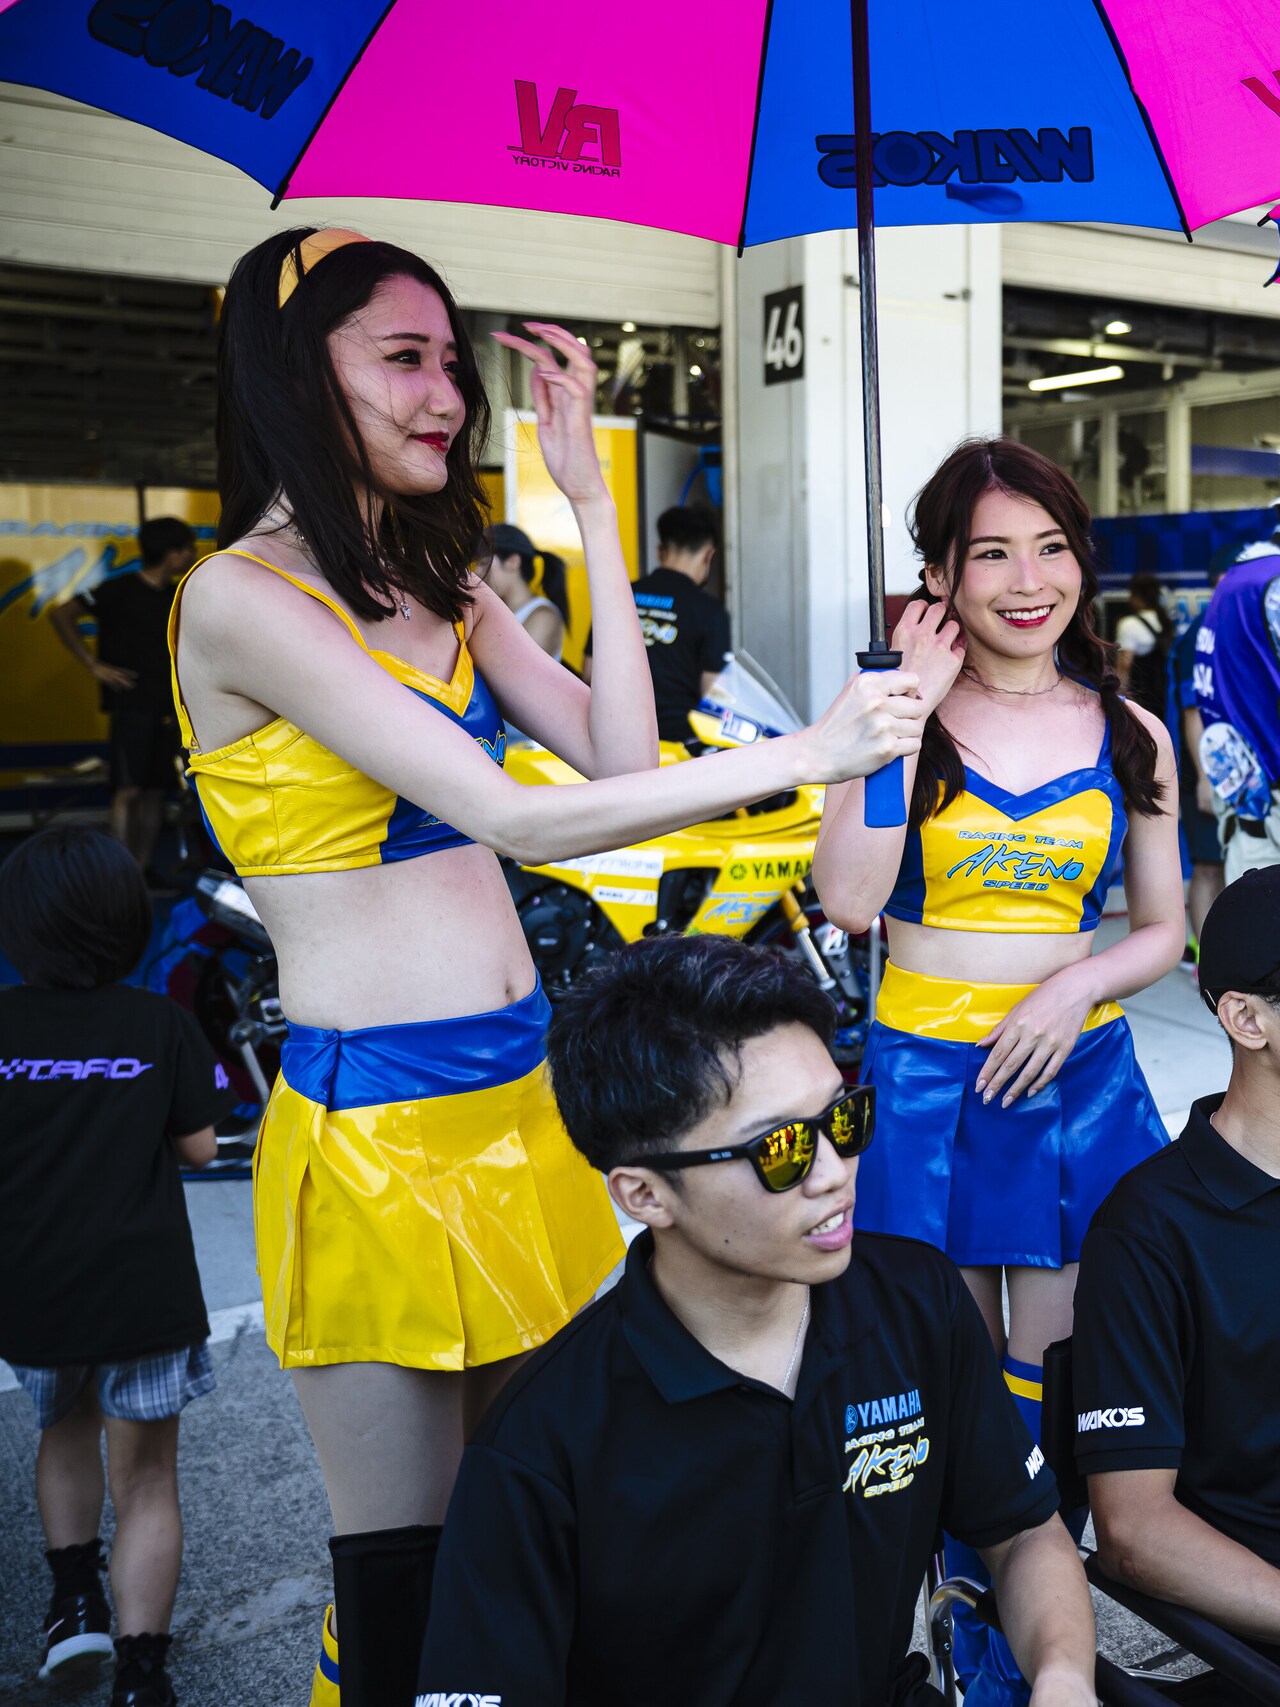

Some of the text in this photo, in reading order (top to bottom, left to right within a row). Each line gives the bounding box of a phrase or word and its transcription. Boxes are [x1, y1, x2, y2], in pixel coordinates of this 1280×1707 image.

[766, 301, 803, 370] 46
[958, 830, 1083, 849] RACING TEAM
[753, 860, 811, 879] YAMA
[946, 843, 1085, 880] AKENO
[983, 880, 1050, 891] SPEED
[857, 1388, 922, 1428] YAMAHA
[844, 1416, 925, 1453] RACING TEAM
[842, 1435, 930, 1494] AKENO
[863, 1472, 915, 1498] SPEED
